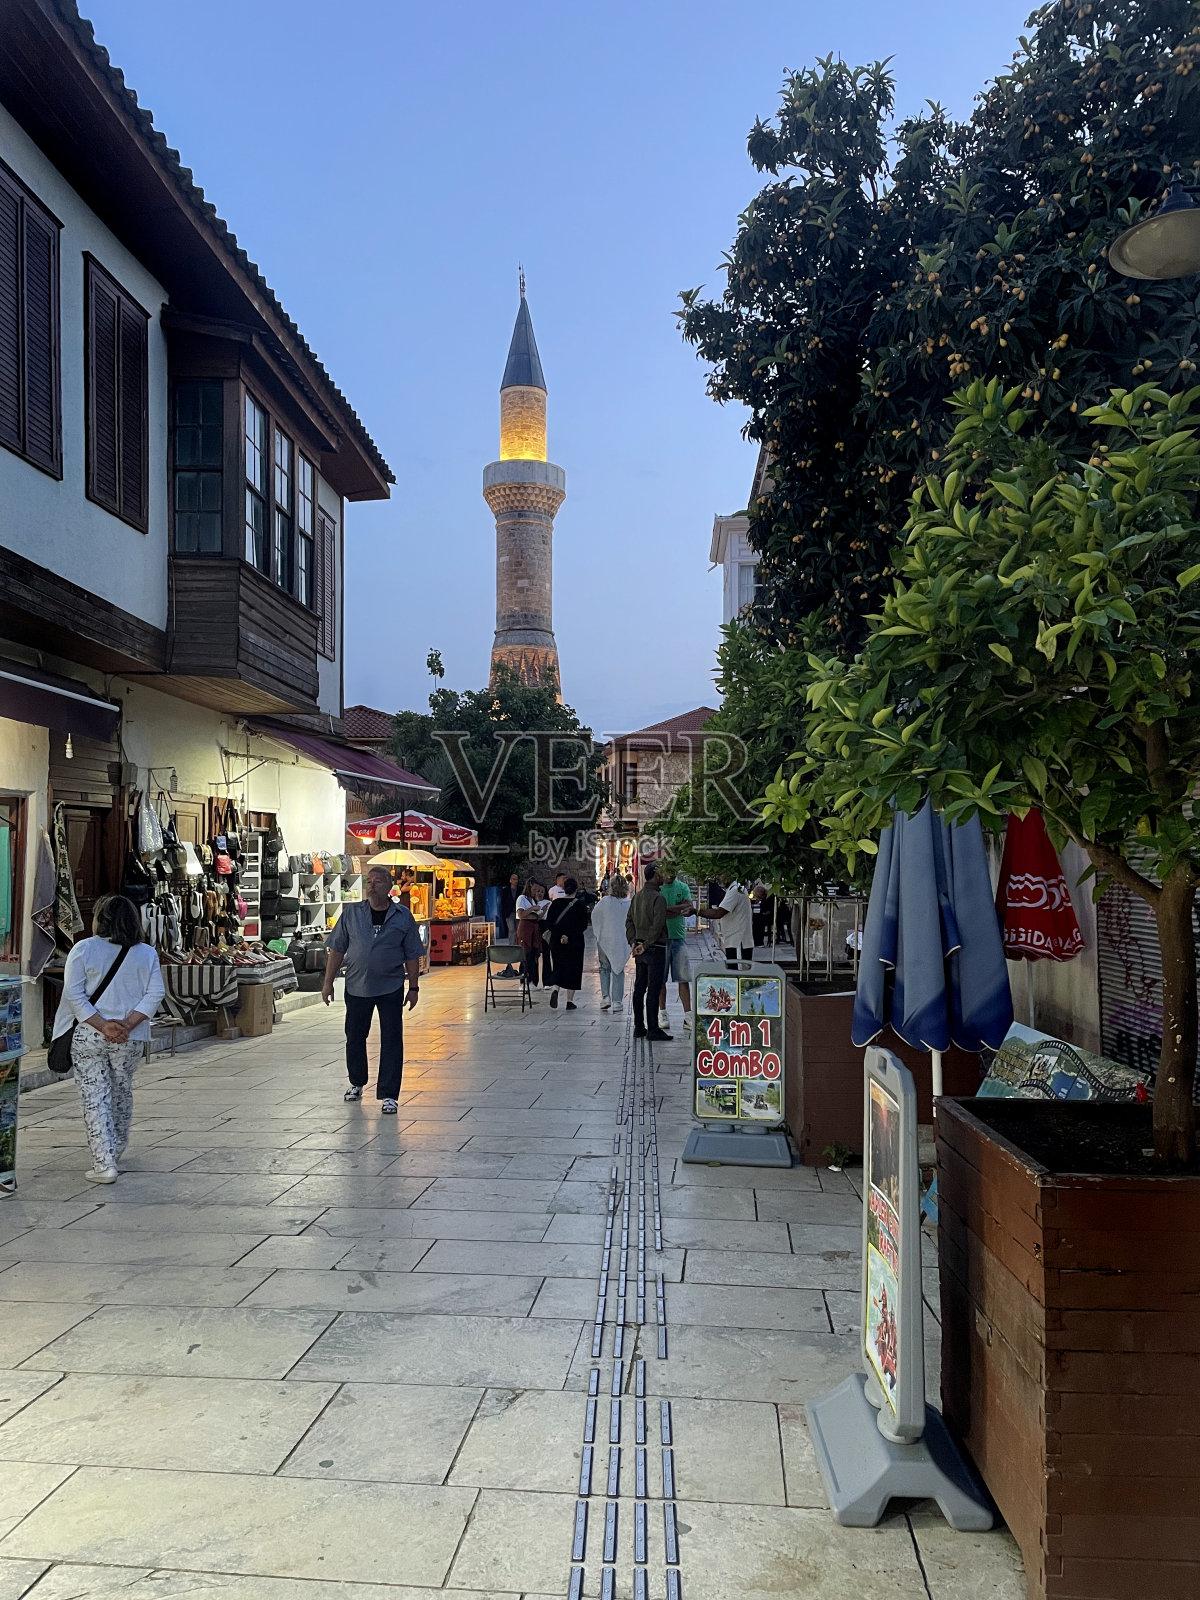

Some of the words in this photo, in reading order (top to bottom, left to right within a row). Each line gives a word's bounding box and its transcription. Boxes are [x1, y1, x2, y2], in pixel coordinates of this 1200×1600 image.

[707, 1018, 724, 1047] 4
[729, 1020, 752, 1047] in
[757, 1019, 771, 1047] 1
